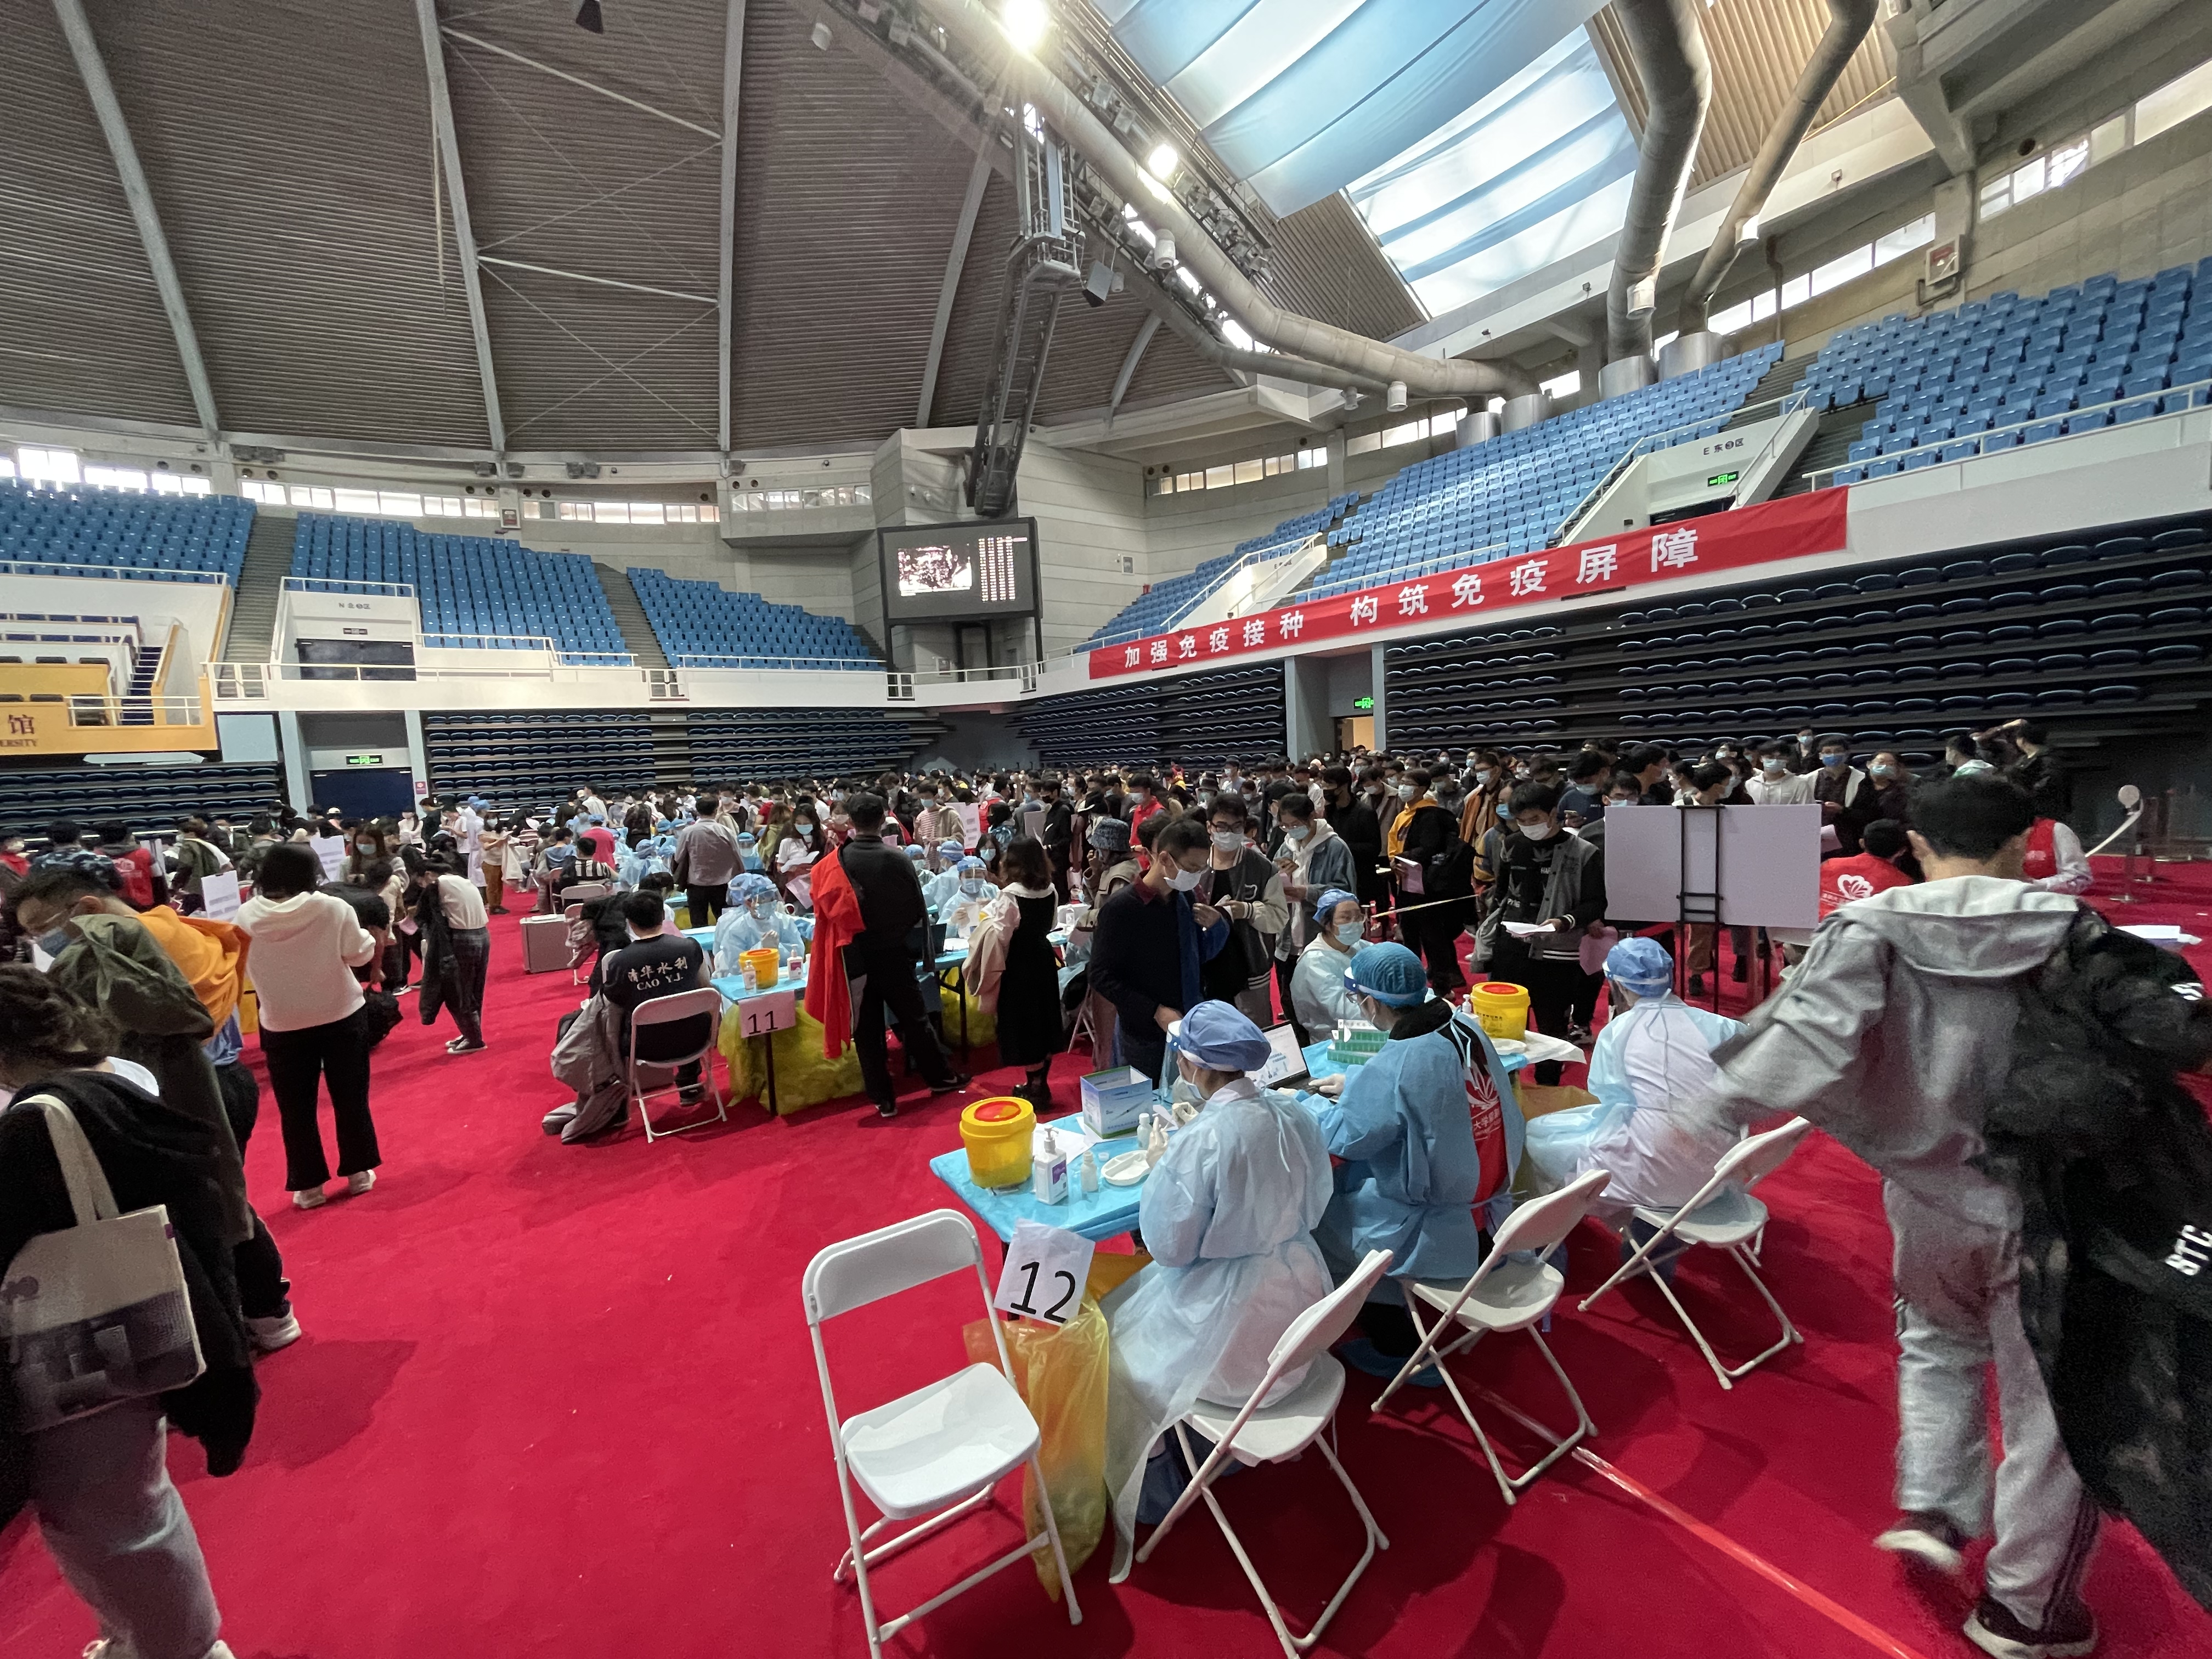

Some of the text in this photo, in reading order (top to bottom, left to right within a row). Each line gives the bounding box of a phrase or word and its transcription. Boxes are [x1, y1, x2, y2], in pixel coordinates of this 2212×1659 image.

[1125, 528, 1699, 668] 加强免疫接种 构筑免疫屏障
[636, 979, 660, 991] CAO
[748, 1011, 778, 1035] 11
[1011, 1261, 1076, 1324] 12
